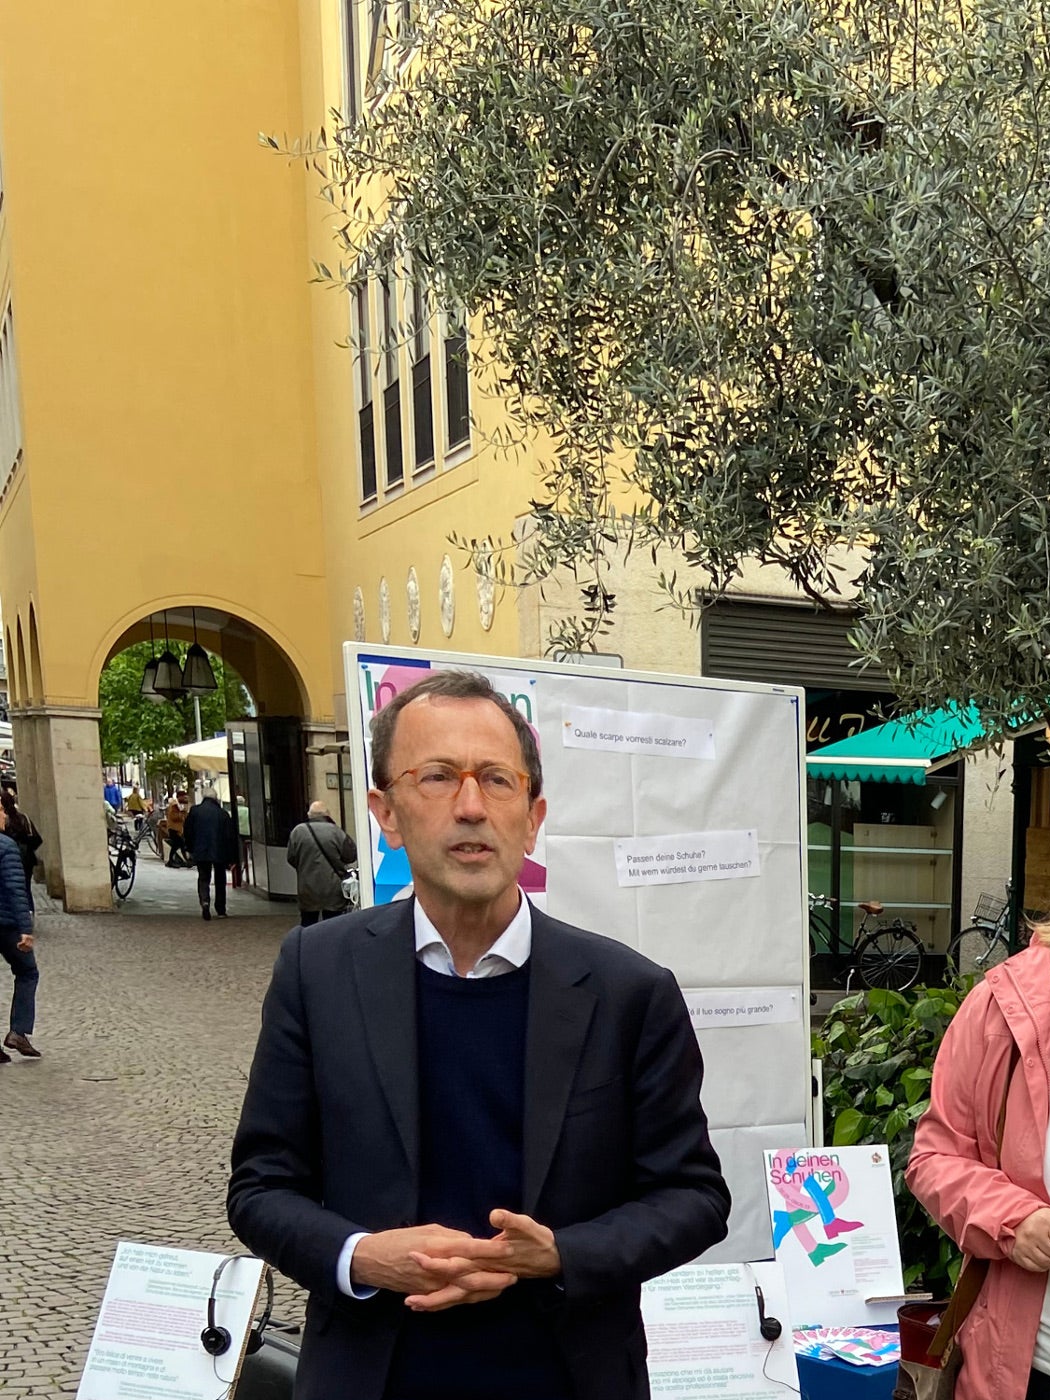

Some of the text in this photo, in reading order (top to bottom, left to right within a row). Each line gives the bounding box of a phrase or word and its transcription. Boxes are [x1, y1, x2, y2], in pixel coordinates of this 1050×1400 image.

[575, 729, 597, 739] Quale
[599, 732, 624, 742] scarpe
[625, 735, 653, 744] vorresti
[626, 850, 705, 863] Passen deine Schuhe?
[629, 860, 752, 877] Mit wem würdest du gerne tauschen?
[715, 1008, 735, 1016] sogno
[747, 1004, 773, 1014] grande?
[768, 1152, 839, 1168] In deinen
